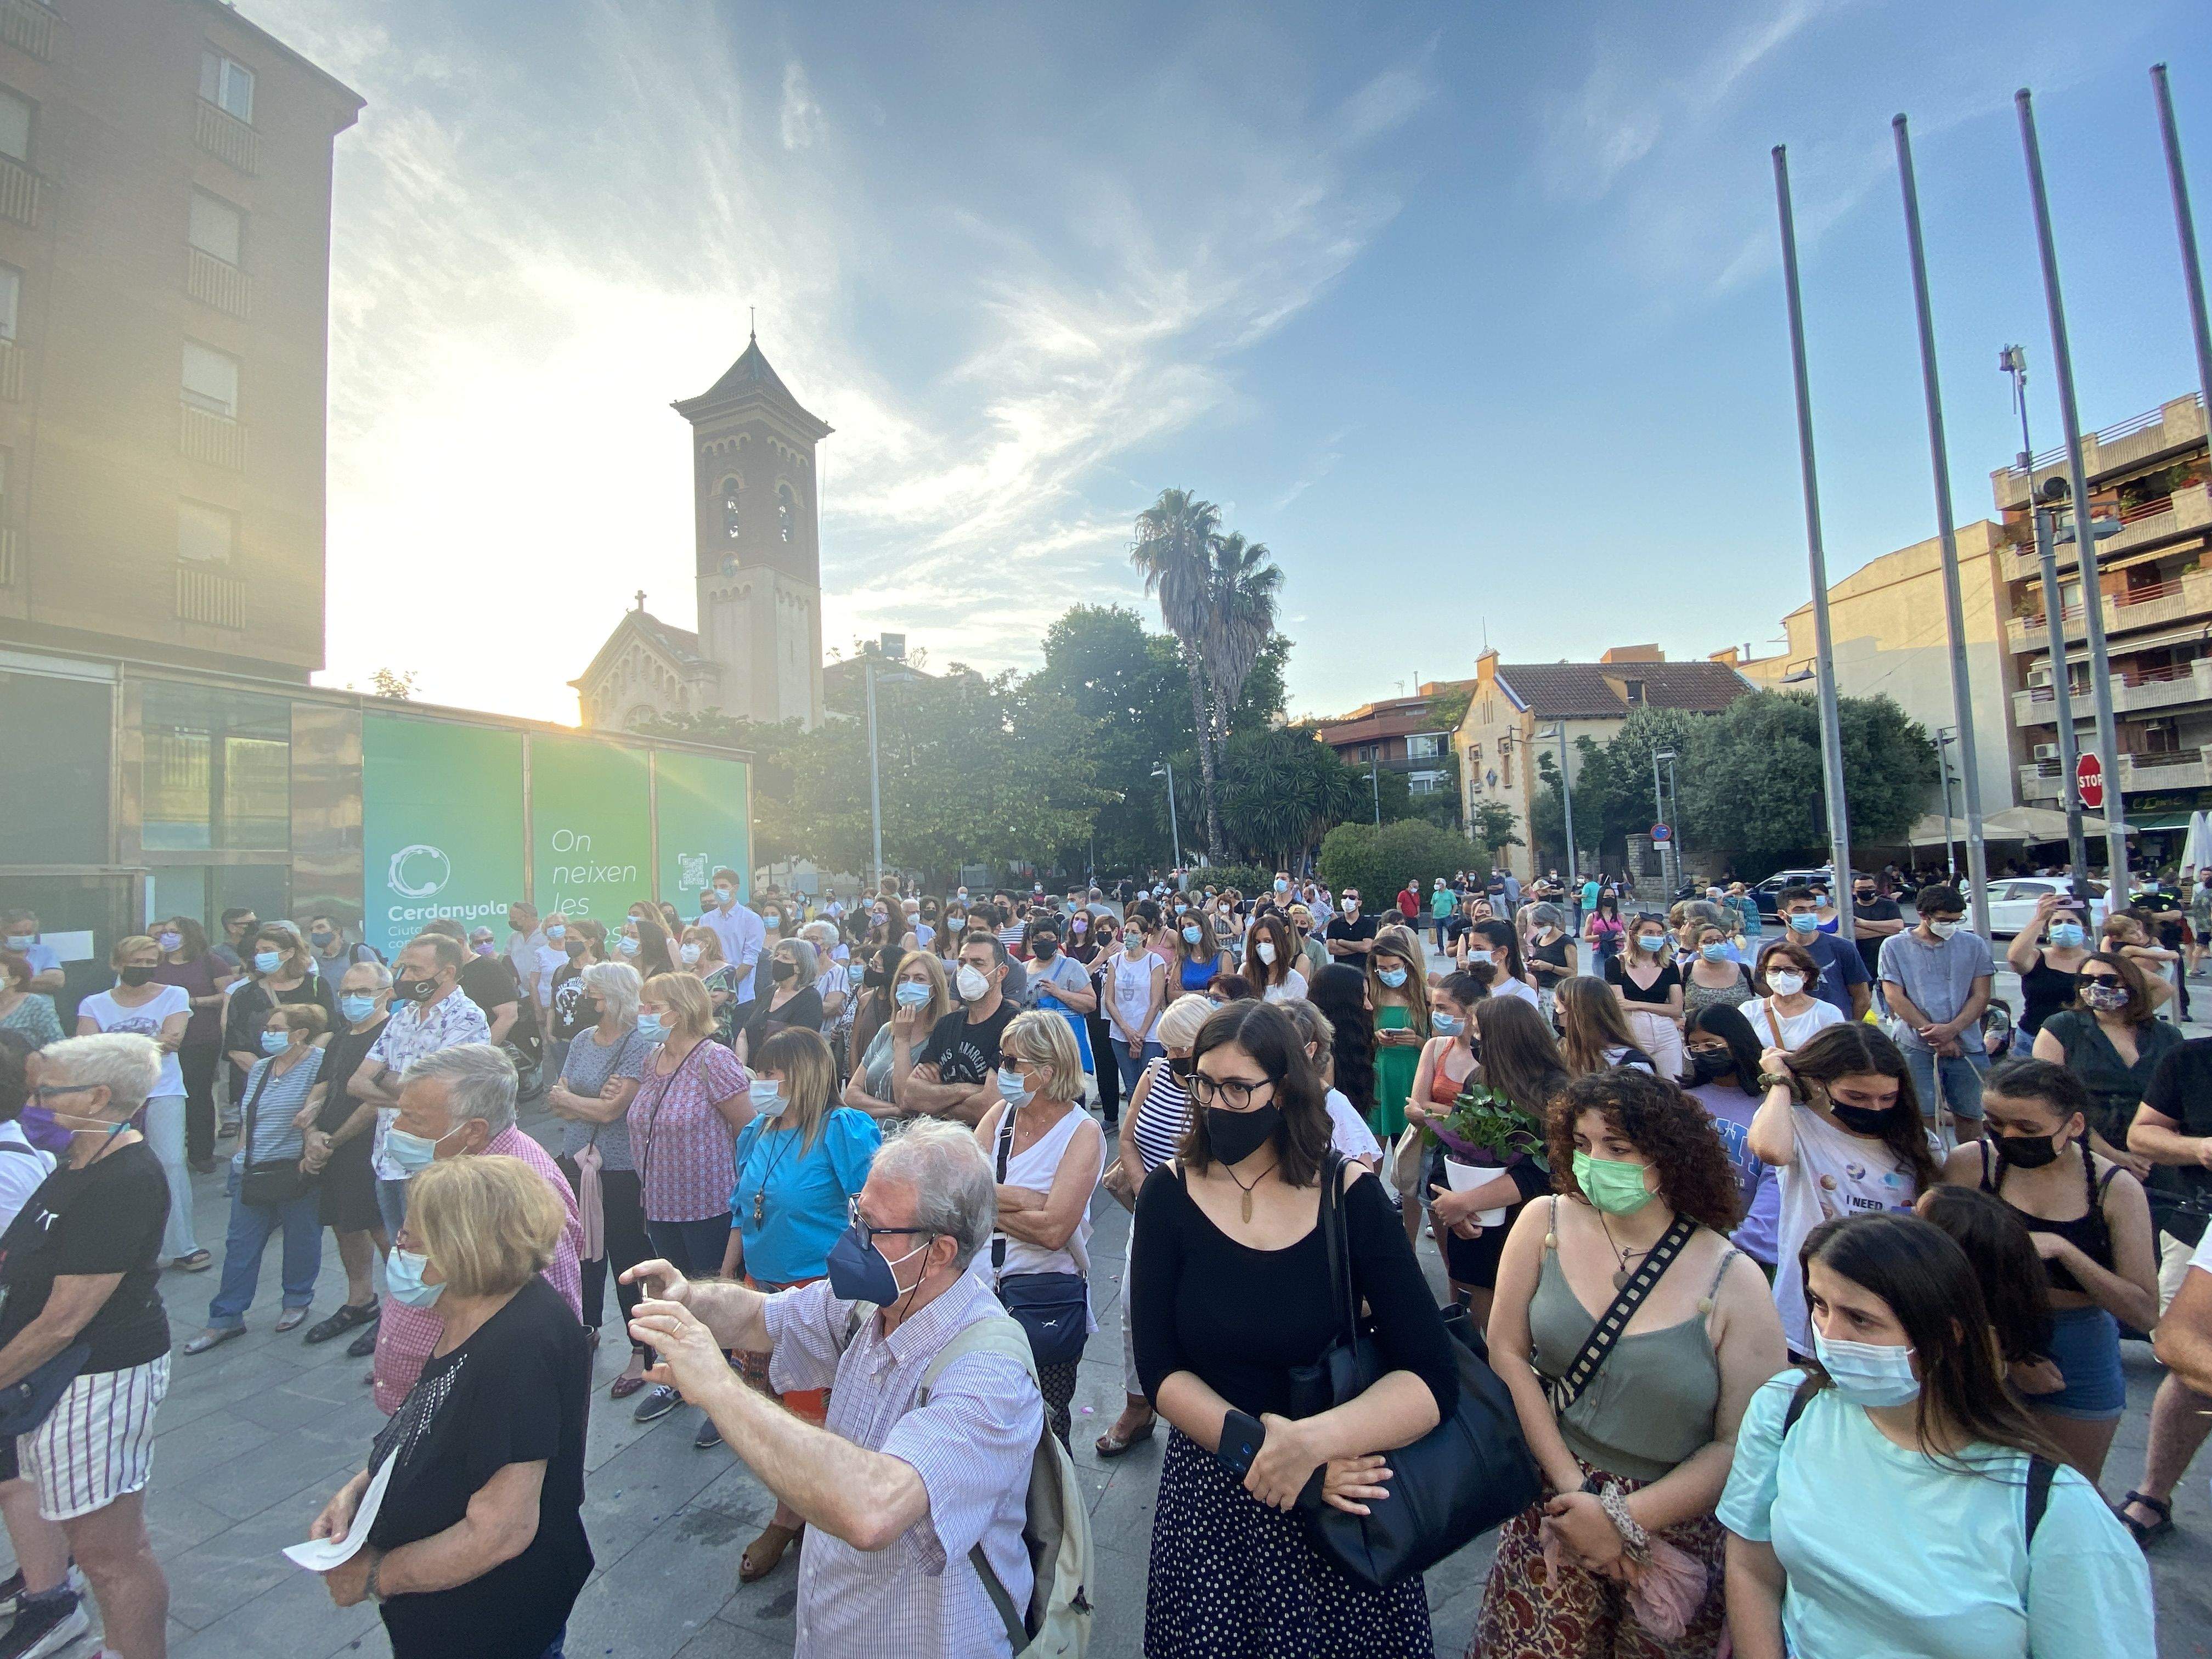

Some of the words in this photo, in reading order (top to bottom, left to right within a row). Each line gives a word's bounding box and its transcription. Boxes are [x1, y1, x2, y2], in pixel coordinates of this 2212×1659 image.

[552, 829, 591, 852] On
[552, 860, 636, 884] neixen
[388, 900, 508, 922] Cerdanyola
[554, 891, 590, 916] les
[388, 926, 422, 936] Ciuta
[1852, 1197, 1883, 1211] NEED
